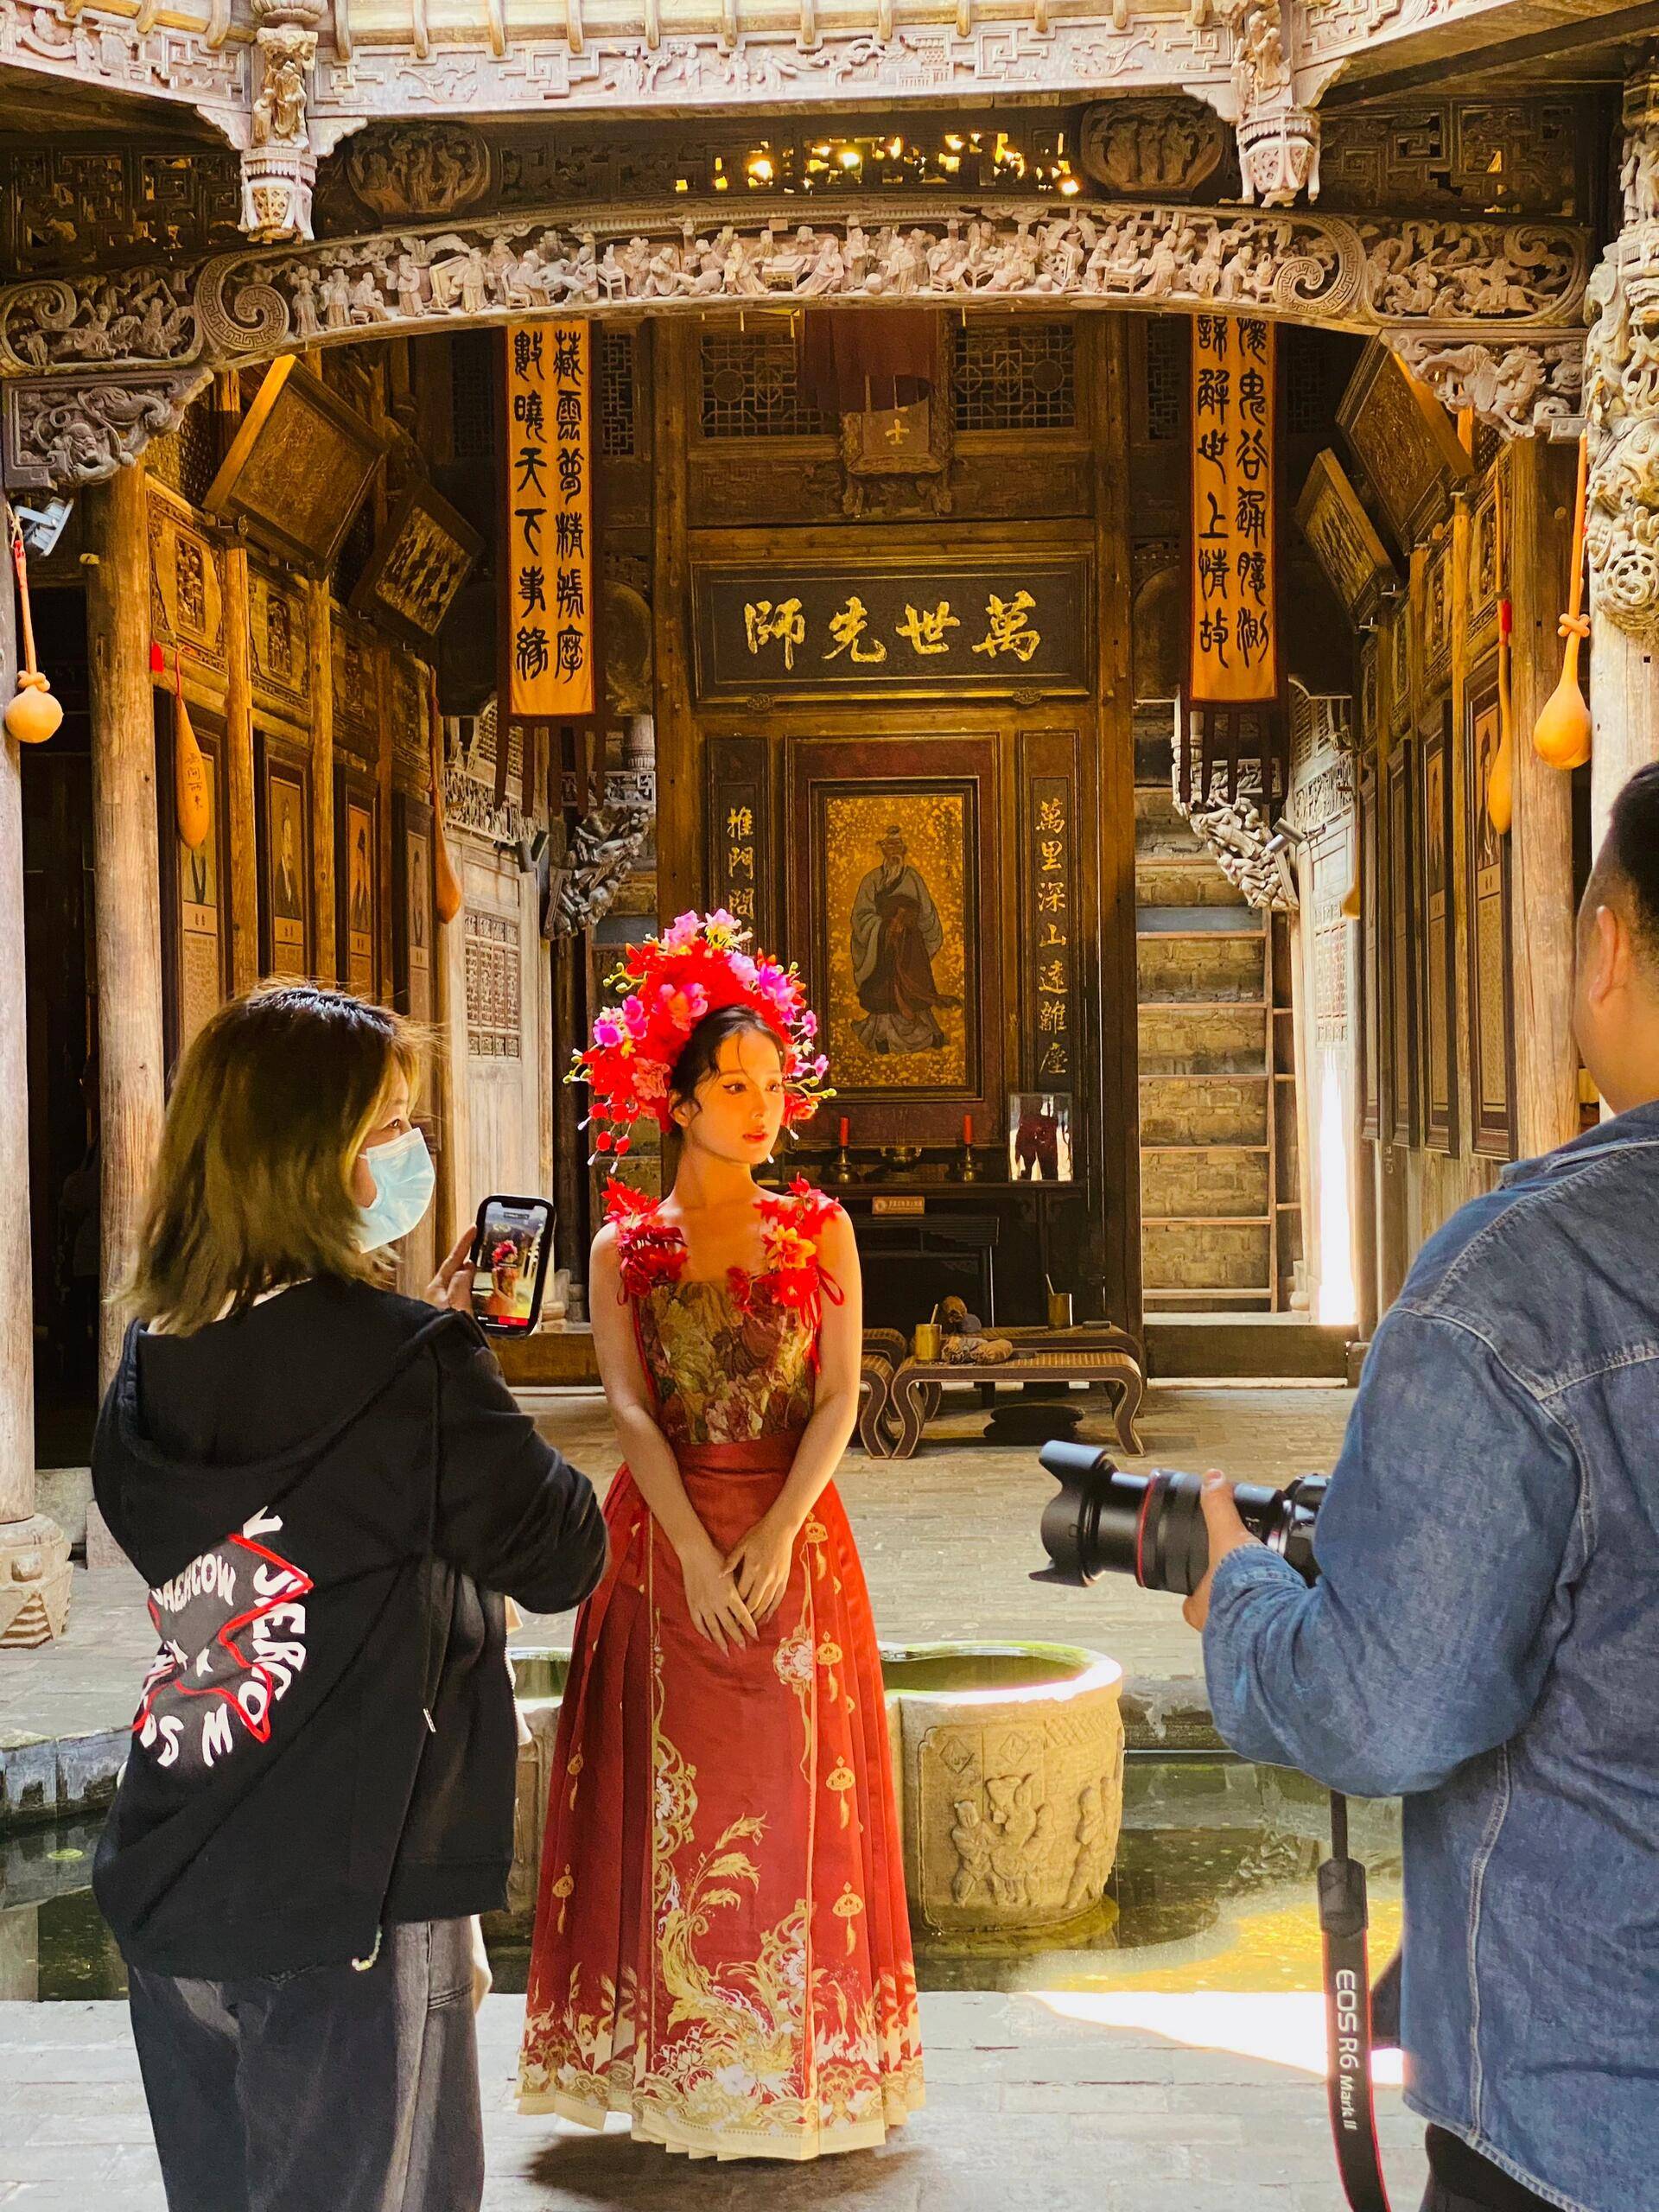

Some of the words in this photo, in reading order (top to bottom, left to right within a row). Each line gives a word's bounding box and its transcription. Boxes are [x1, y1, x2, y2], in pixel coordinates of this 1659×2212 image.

[727, 805, 754, 954] 推門問
[1336, 1968, 1357, 2032] EOS
[1338, 2037, 1359, 2069] R6
[1339, 2074, 1355, 2117] Mark
